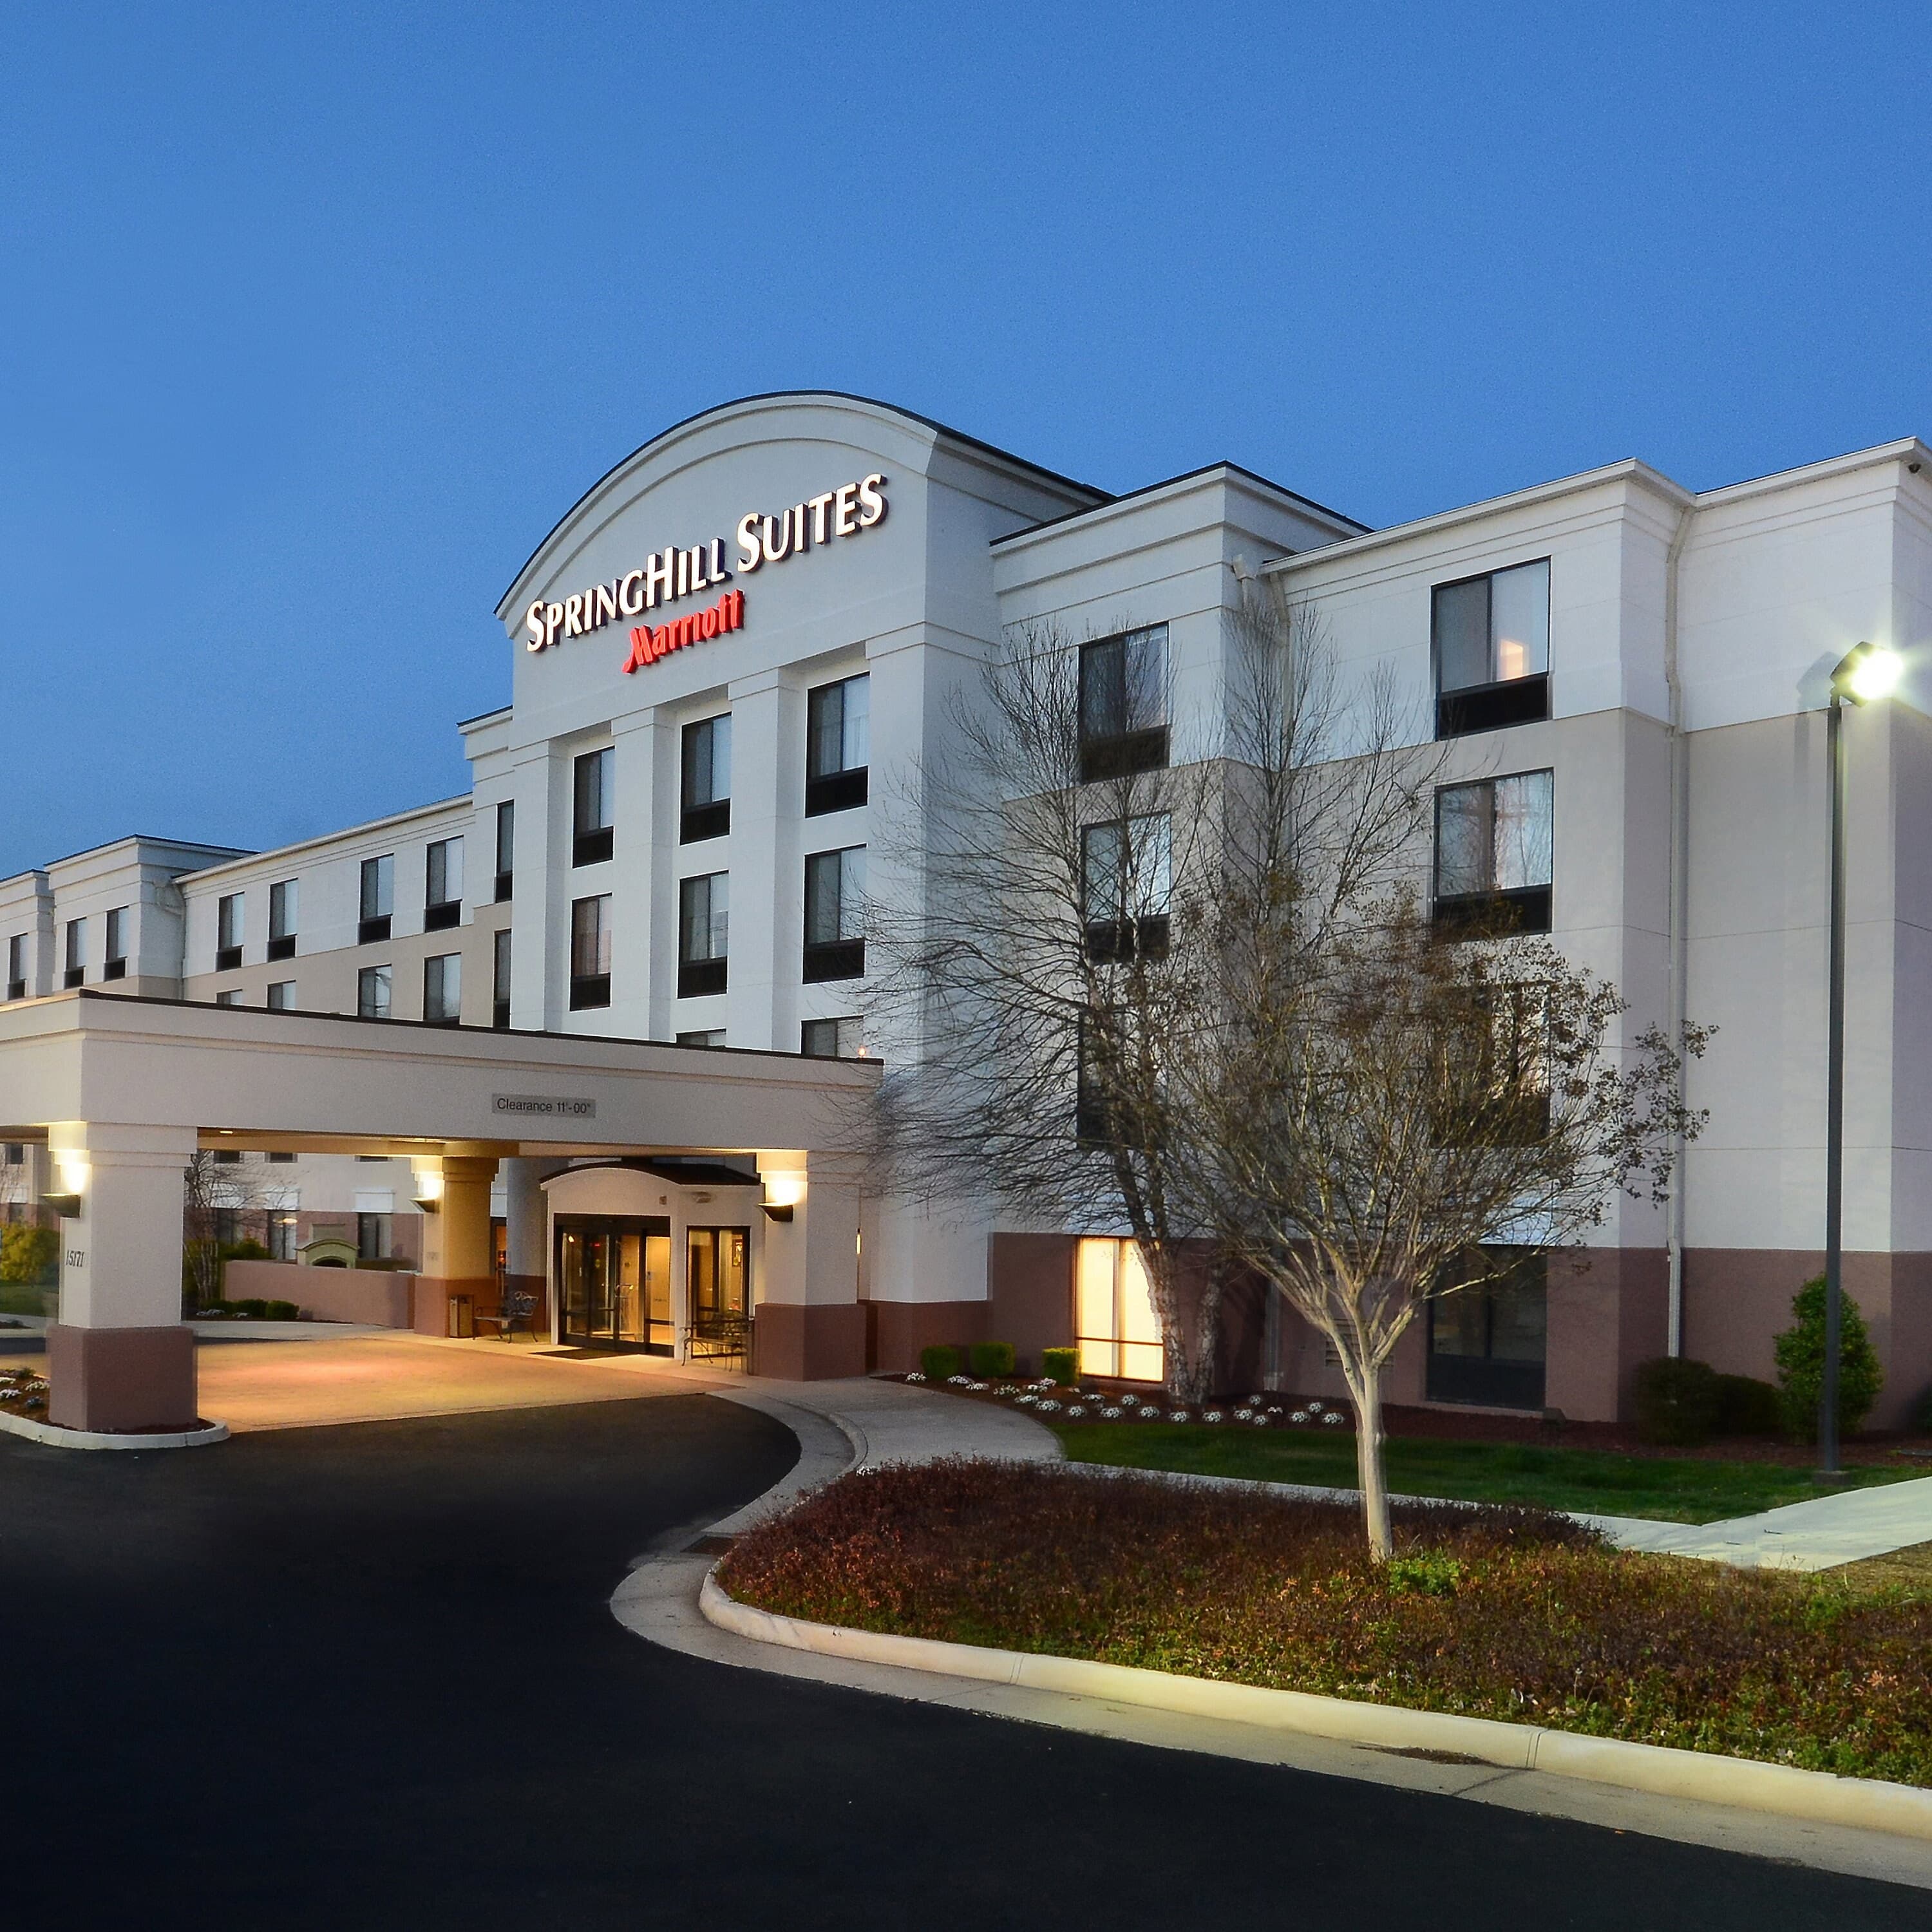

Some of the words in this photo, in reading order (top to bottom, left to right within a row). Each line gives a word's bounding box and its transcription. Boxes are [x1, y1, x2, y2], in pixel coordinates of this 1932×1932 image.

[526, 537, 733, 652] SPRINGHILL
[736, 473, 888, 573] SUITES
[622, 589, 744, 674] Marriott
[497, 1097, 553, 1112] Clearance
